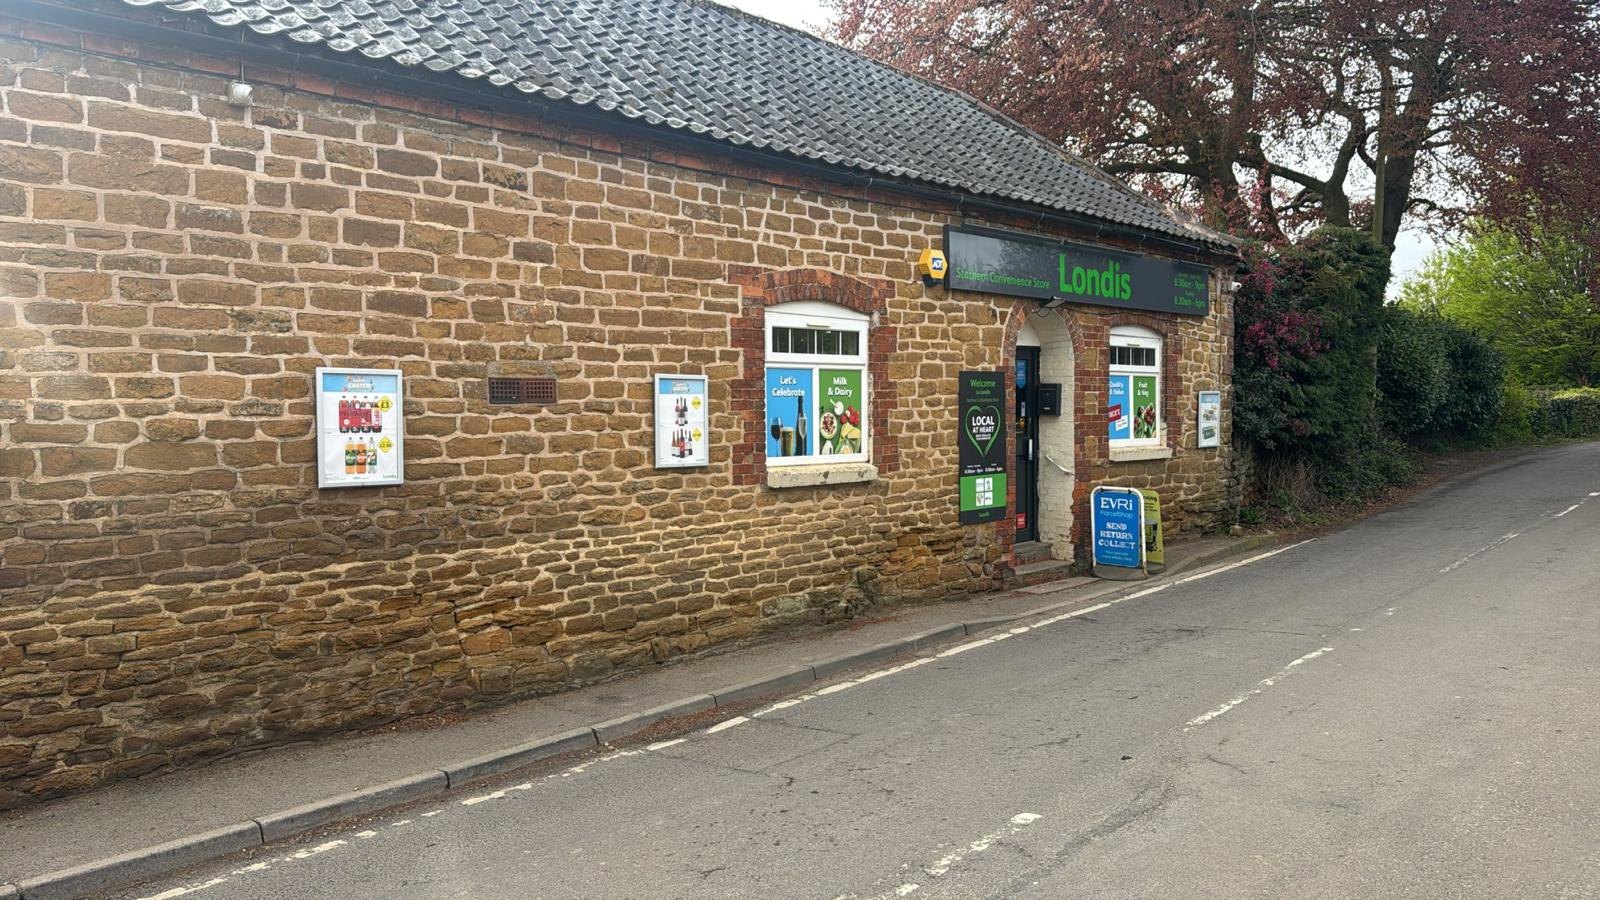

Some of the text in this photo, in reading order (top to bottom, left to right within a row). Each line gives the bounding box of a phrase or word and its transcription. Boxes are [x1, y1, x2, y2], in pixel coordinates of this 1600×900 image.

[989, 272, 1033, 287] Convenience
[1033, 278, 1050, 290] Store
[1059, 253, 1131, 300] Londis
[780, 375, 797, 385] Let's
[833, 377, 848, 386] Milk
[970, 379, 996, 388] Welcome
[772, 388, 806, 397] Celebrate
[827, 388, 853, 398] & Dairy
[972, 415, 995, 427] LOCAL
[1101, 511, 1133, 519] ParcelShop
[1106, 522, 1127, 530] SEND
[1101, 531, 1133, 540] RETURN
[1098, 539, 1135, 549] COLLECT
